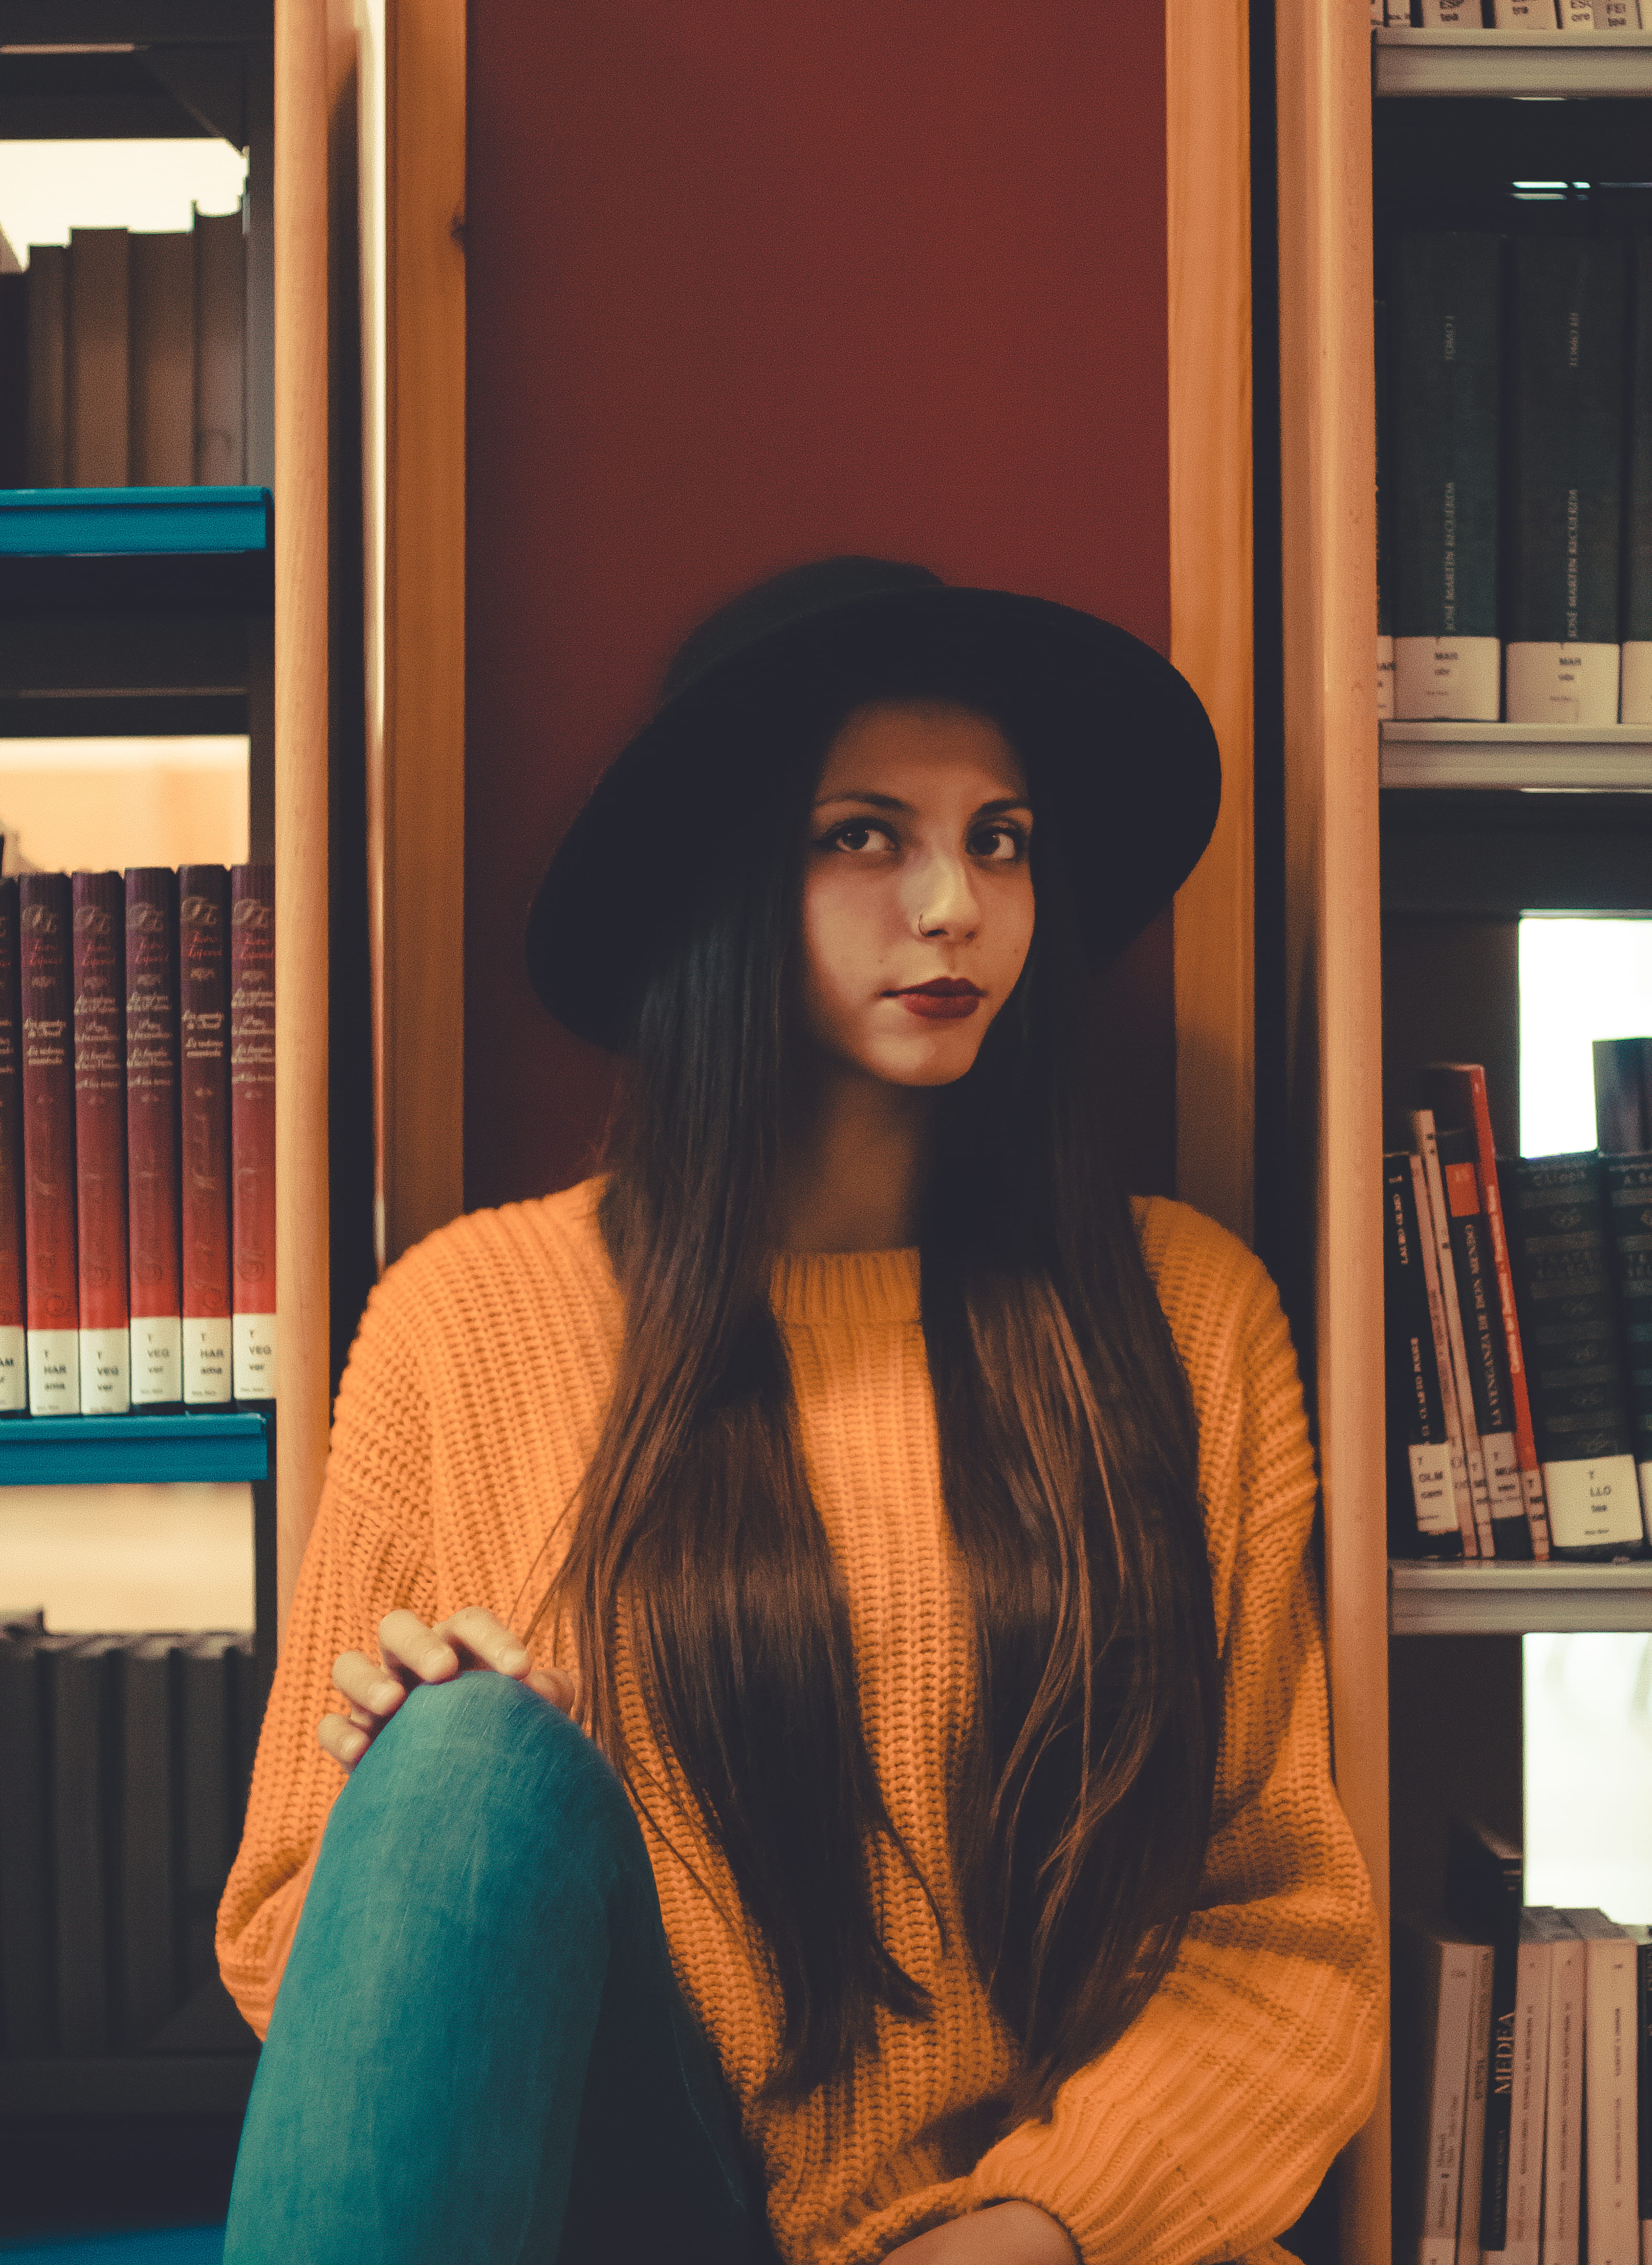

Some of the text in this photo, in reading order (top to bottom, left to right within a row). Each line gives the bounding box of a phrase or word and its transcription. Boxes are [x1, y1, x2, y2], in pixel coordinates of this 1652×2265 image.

[147, 1349, 169, 1357] VEG
[200, 1349, 224, 1357] HAR
[249, 1346, 271, 1355] VEG
[44, 1365, 66, 1374] HAR
[97, 1367, 119, 1375] VEG
[1494, 2013, 1515, 2094] MEDEA
